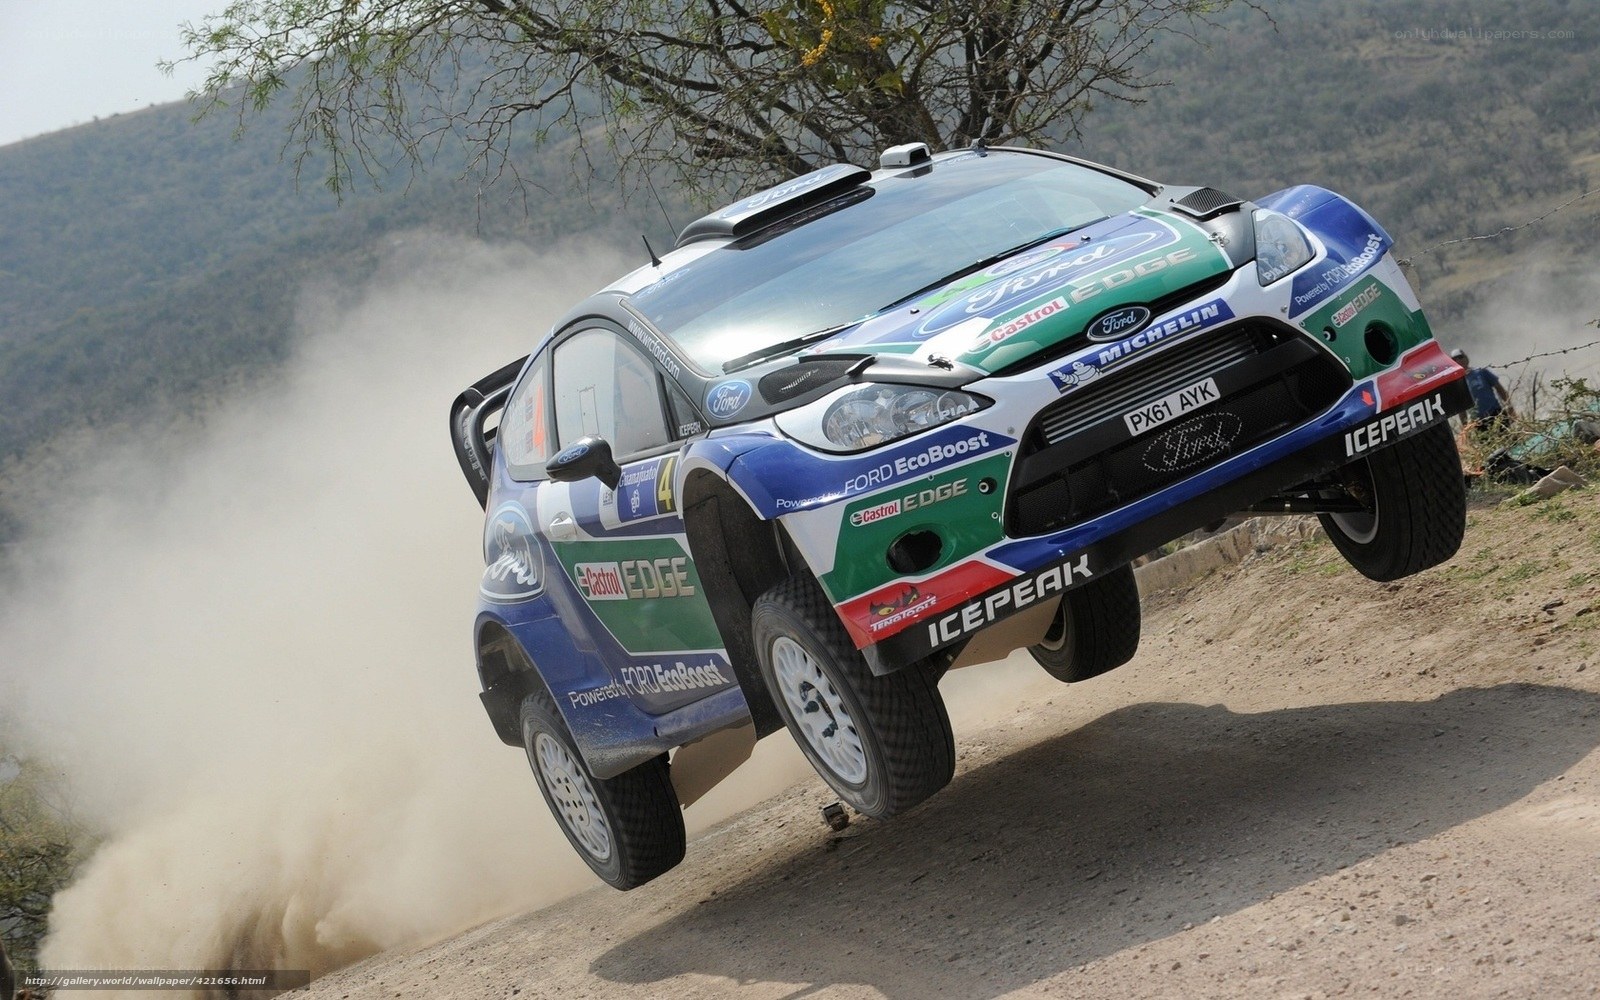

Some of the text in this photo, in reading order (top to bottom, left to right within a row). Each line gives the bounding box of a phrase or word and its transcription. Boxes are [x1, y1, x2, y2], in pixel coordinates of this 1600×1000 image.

[965, 244, 1115, 314] Ford
[1070, 247, 1197, 305] EDGE
[1294, 285, 1324, 306] Powered
[1322, 264, 1349, 287] FORD
[1346, 233, 1382, 274] EcoBoost
[990, 299, 1064, 342] Castrol
[1101, 310, 1138, 335] Ford
[1352, 283, 1381, 312] EDGE
[629, 320, 680, 380] www.wrcford.com
[1098, 303, 1222, 366] MICHELIN
[713, 384, 744, 413] Ford
[939, 399, 980, 420] PIAA
[1129, 381, 1215, 431] PX61 AYK
[1163, 421, 1230, 467] Ford
[1345, 393, 1446, 457] ICEPEAK
[658, 457, 674, 510] 4
[776, 493, 830, 509] Powered
[844, 464, 894, 495] FORD
[894, 431, 990, 476] EcoBoost
[863, 477, 968, 523] Castrol EDGE
[490, 519, 538, 585] Ford
[584, 557, 695, 600] Castrol EDGE
[927, 553, 1093, 648] ICEPEAK
[568, 659, 729, 709] Powered by FORD EcoBoost
